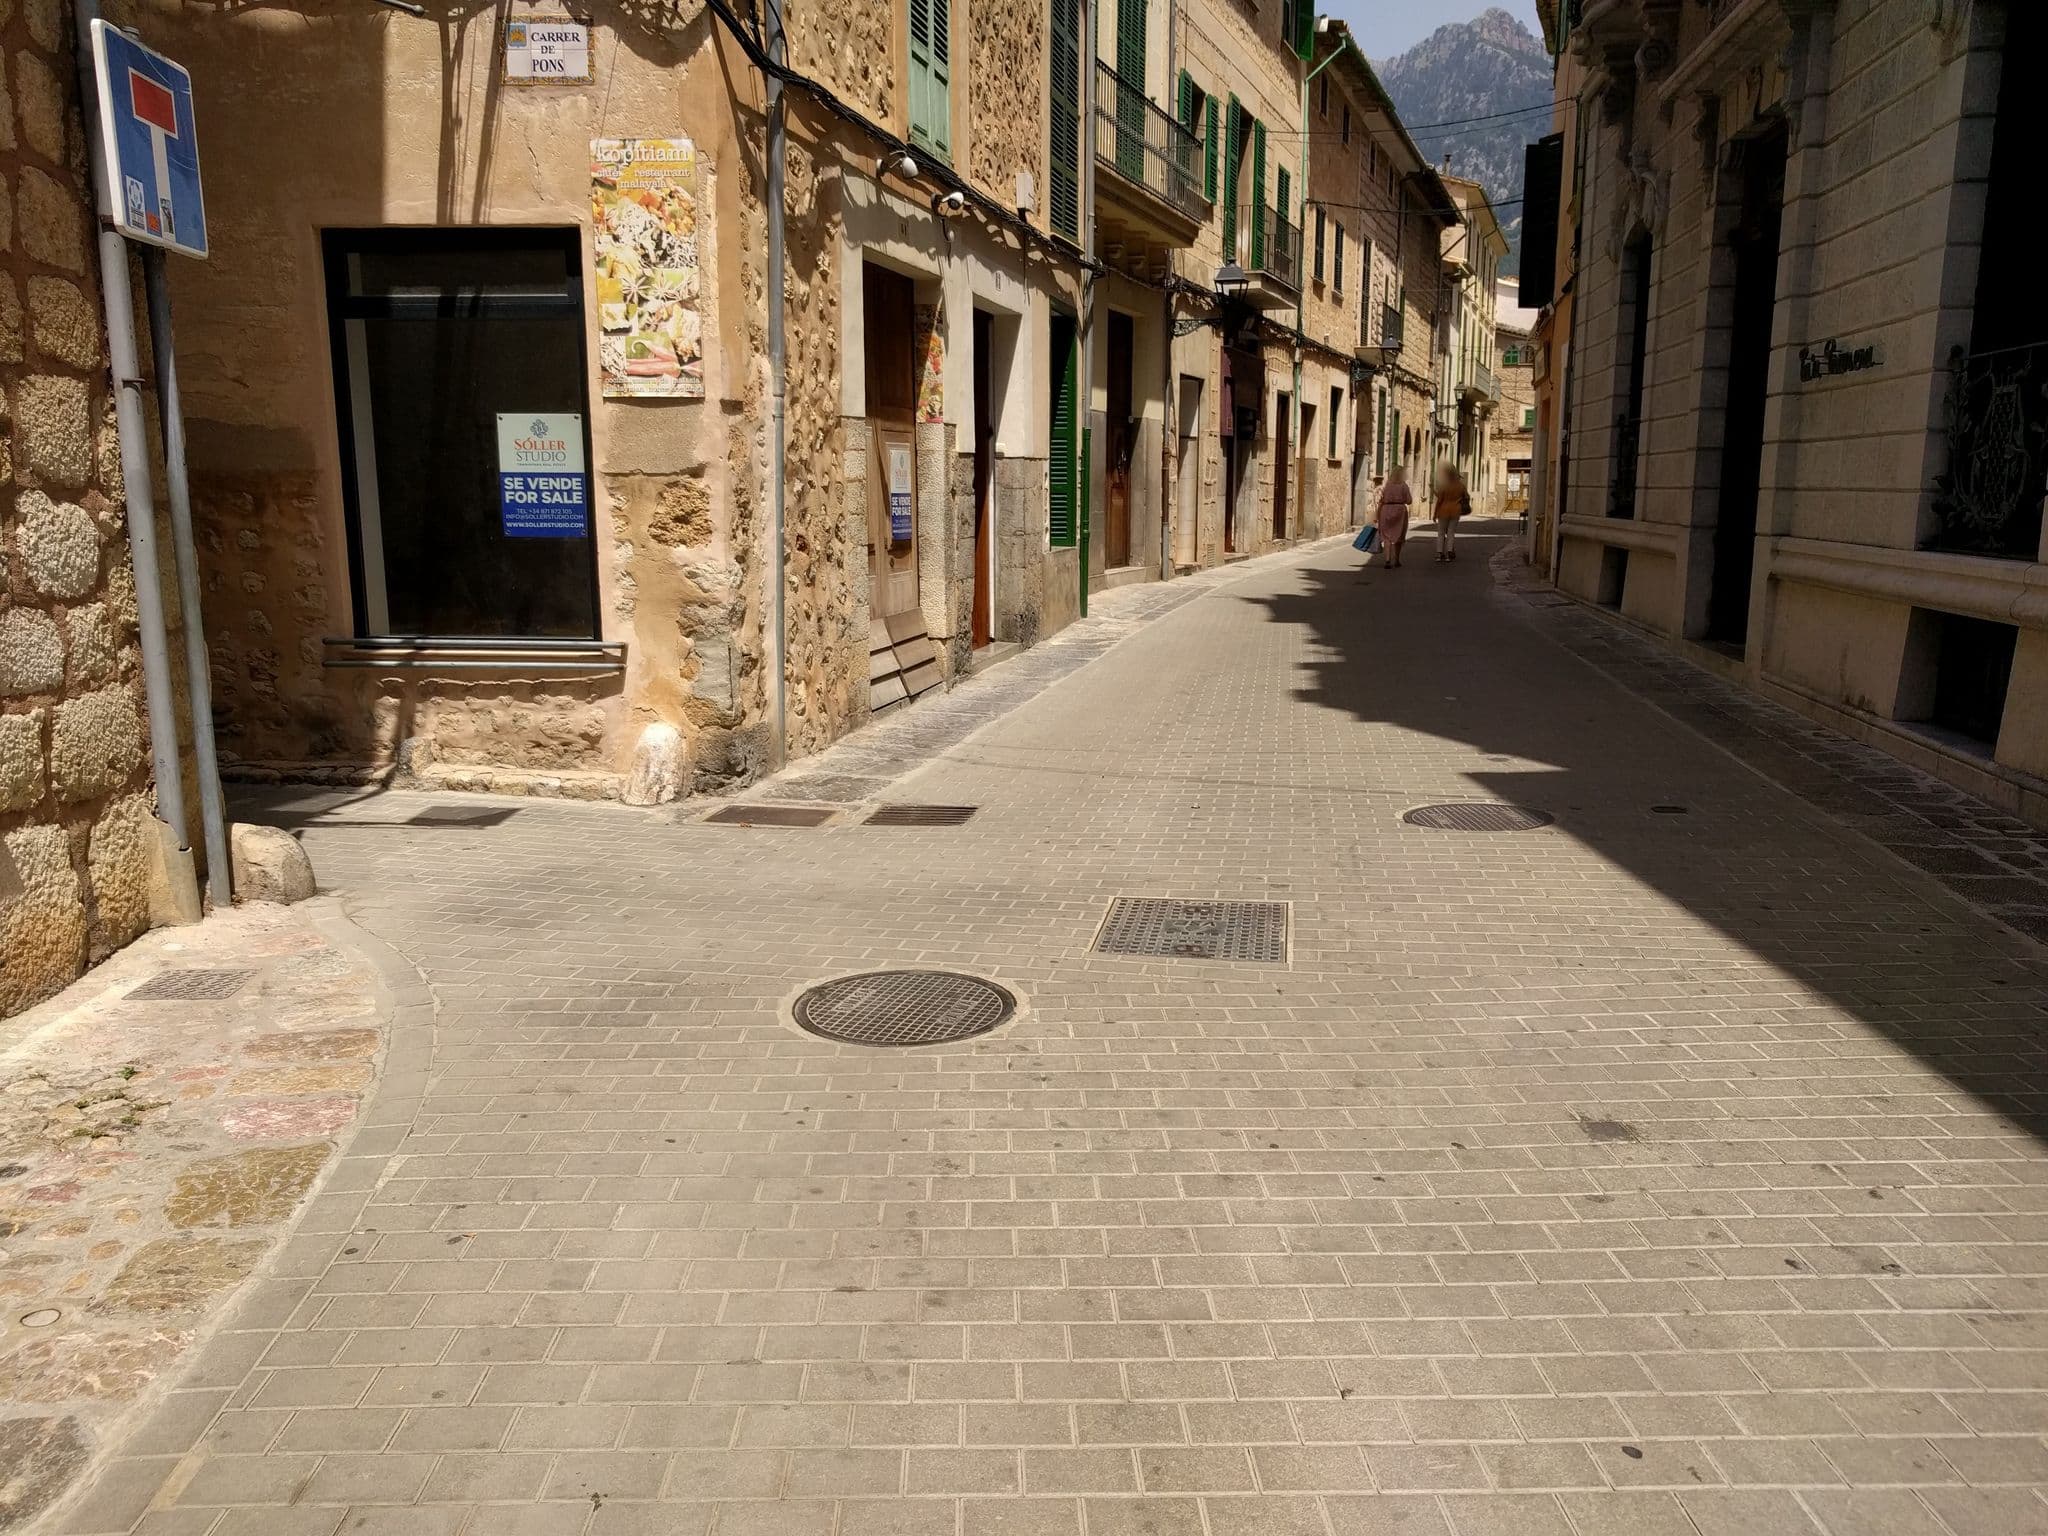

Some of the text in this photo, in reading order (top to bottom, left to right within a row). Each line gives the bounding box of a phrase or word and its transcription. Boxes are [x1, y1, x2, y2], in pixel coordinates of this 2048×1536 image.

[531, 32, 581, 43] CARRER
[541, 45, 555, 54] DE
[532, 59, 564, 72] PONS
[596, 145, 689, 167] kopitiam
[634, 168, 690, 178] restaurant
[514, 437, 566, 451] SÓLLER
[516, 451, 566, 461] STUDIO
[504, 477, 582, 490] SE VENDE
[505, 491, 583, 504] FOR SALE
